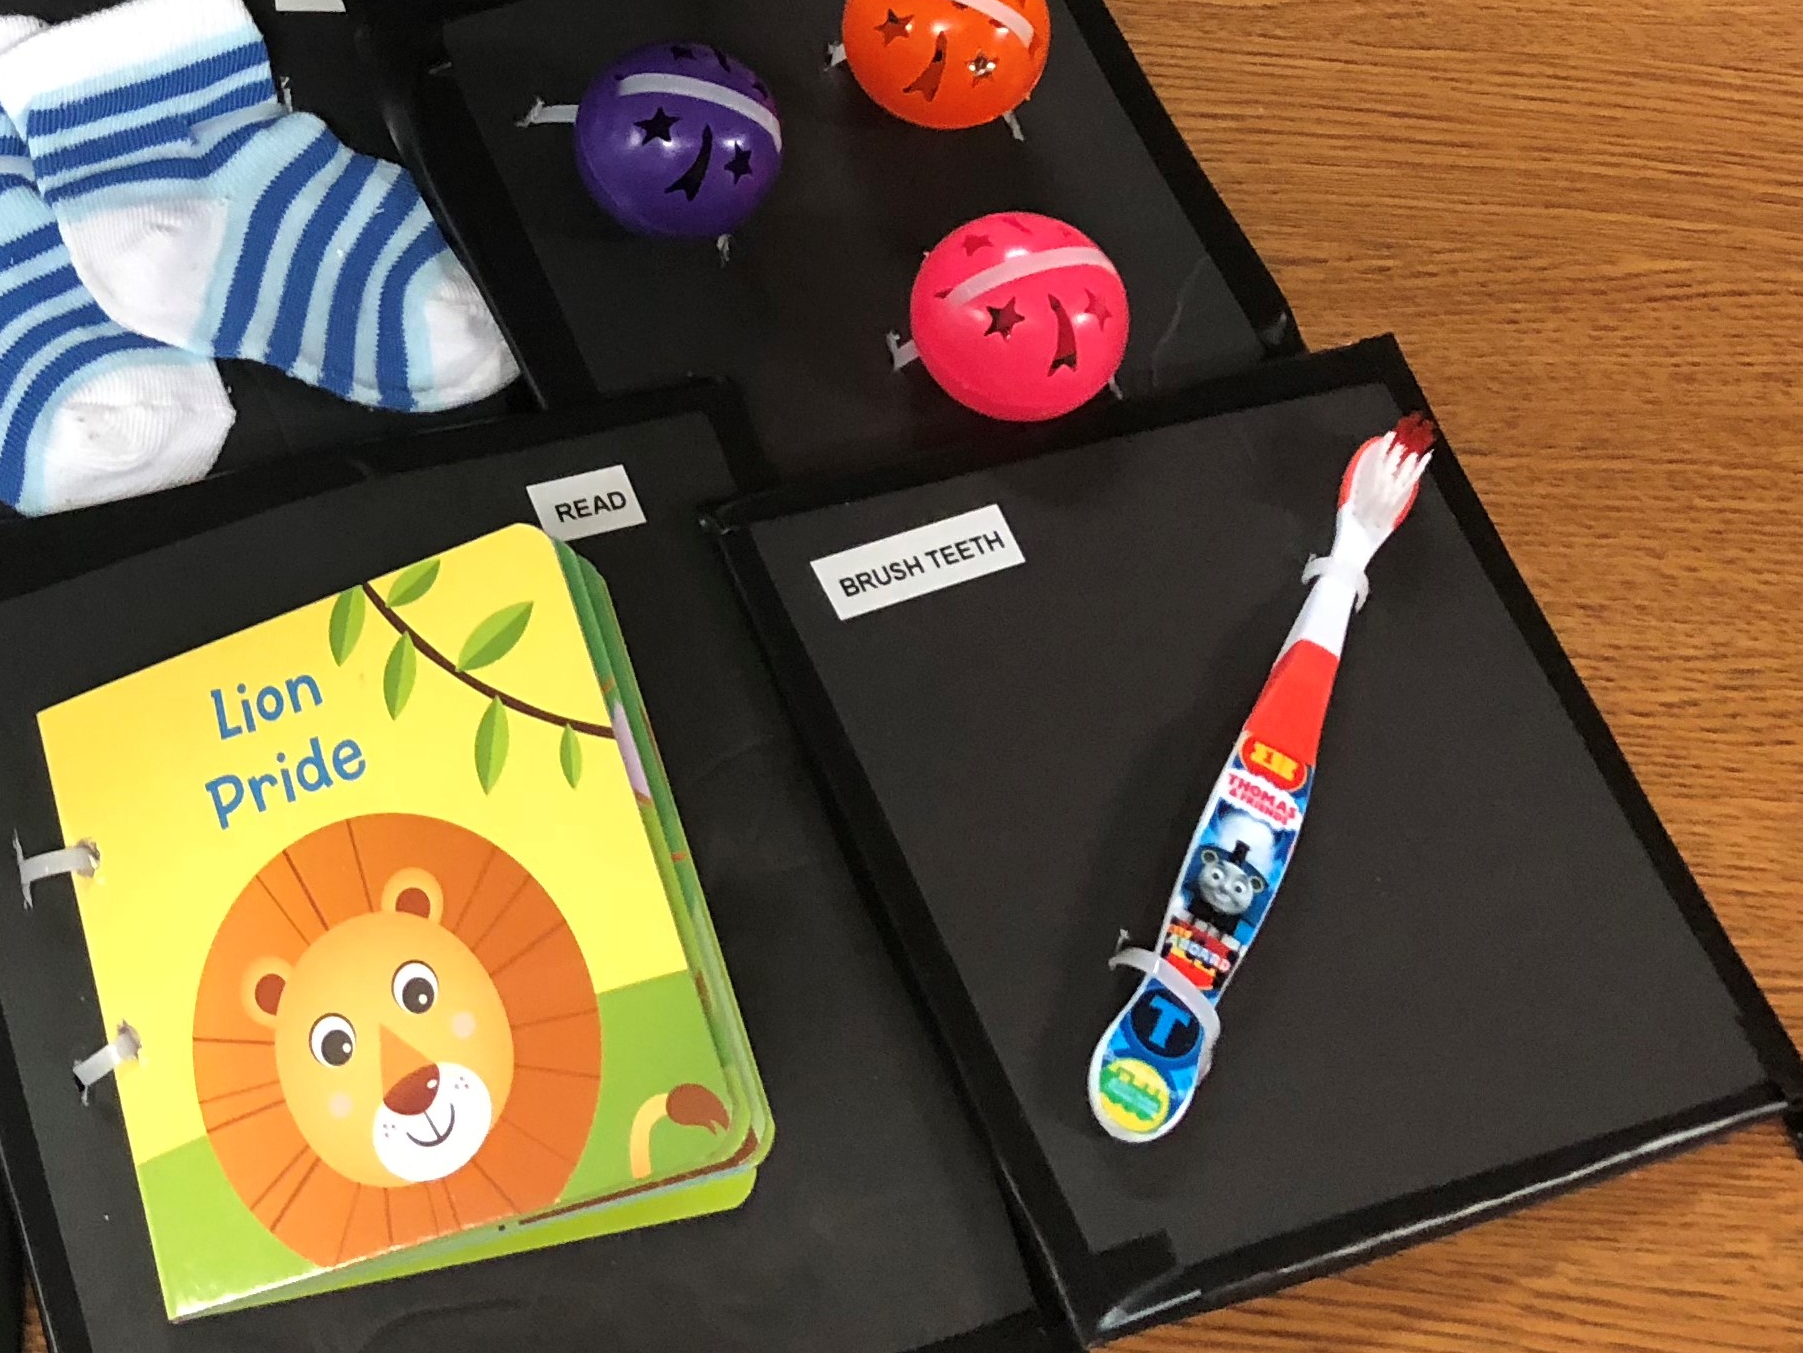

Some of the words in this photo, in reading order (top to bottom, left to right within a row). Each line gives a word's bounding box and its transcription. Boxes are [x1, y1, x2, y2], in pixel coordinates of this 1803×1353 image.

[554, 491, 627, 523] READ
[839, 555, 925, 598] BRUSH
[925, 530, 1005, 569] TEETH
[210, 674, 323, 740] Lion
[204, 736, 366, 830] Pride
[1229, 773, 1296, 819] THOMAS
[1149, 995, 1191, 1048] T
